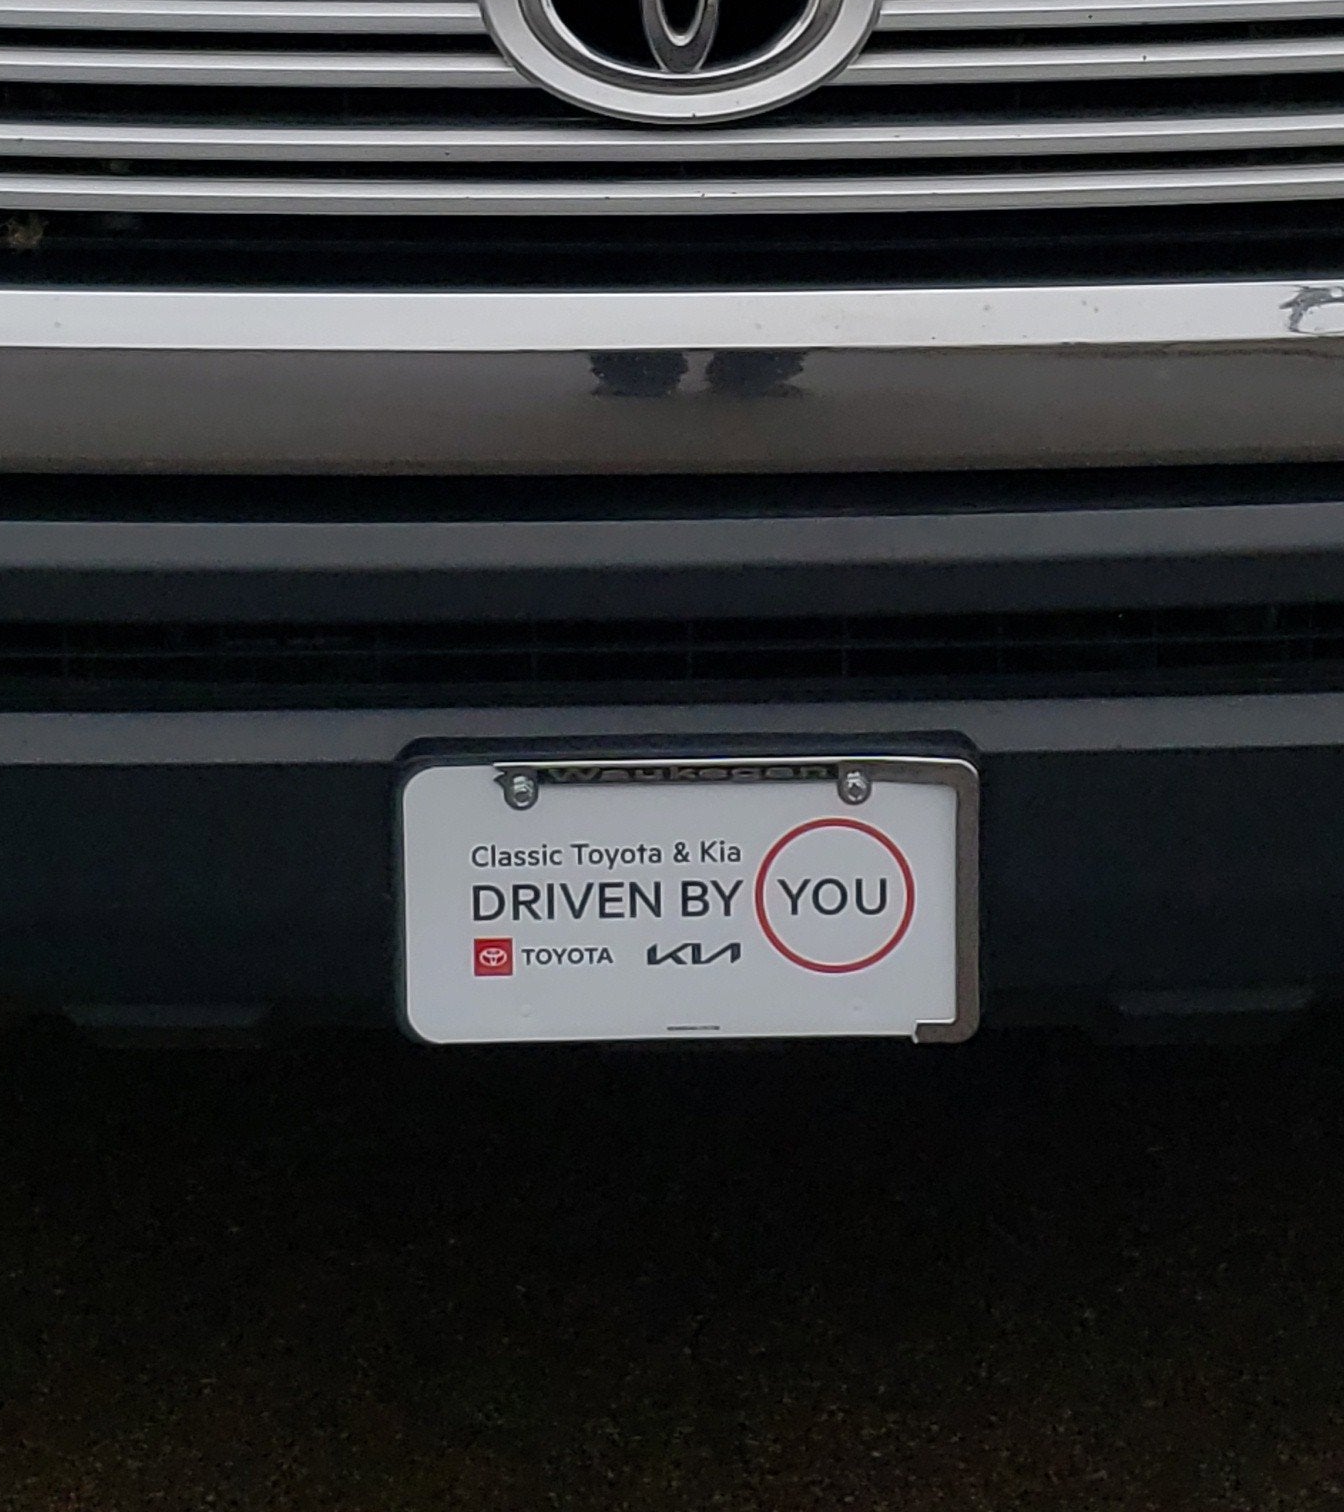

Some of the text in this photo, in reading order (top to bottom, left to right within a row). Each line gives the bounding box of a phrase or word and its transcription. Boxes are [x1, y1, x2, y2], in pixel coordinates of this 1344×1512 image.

[471, 840, 742, 870] Classic Toyota & Kia
[472, 877, 887, 921] DRIVEN BY YOU
[521, 947, 614, 966] TOYOTA
